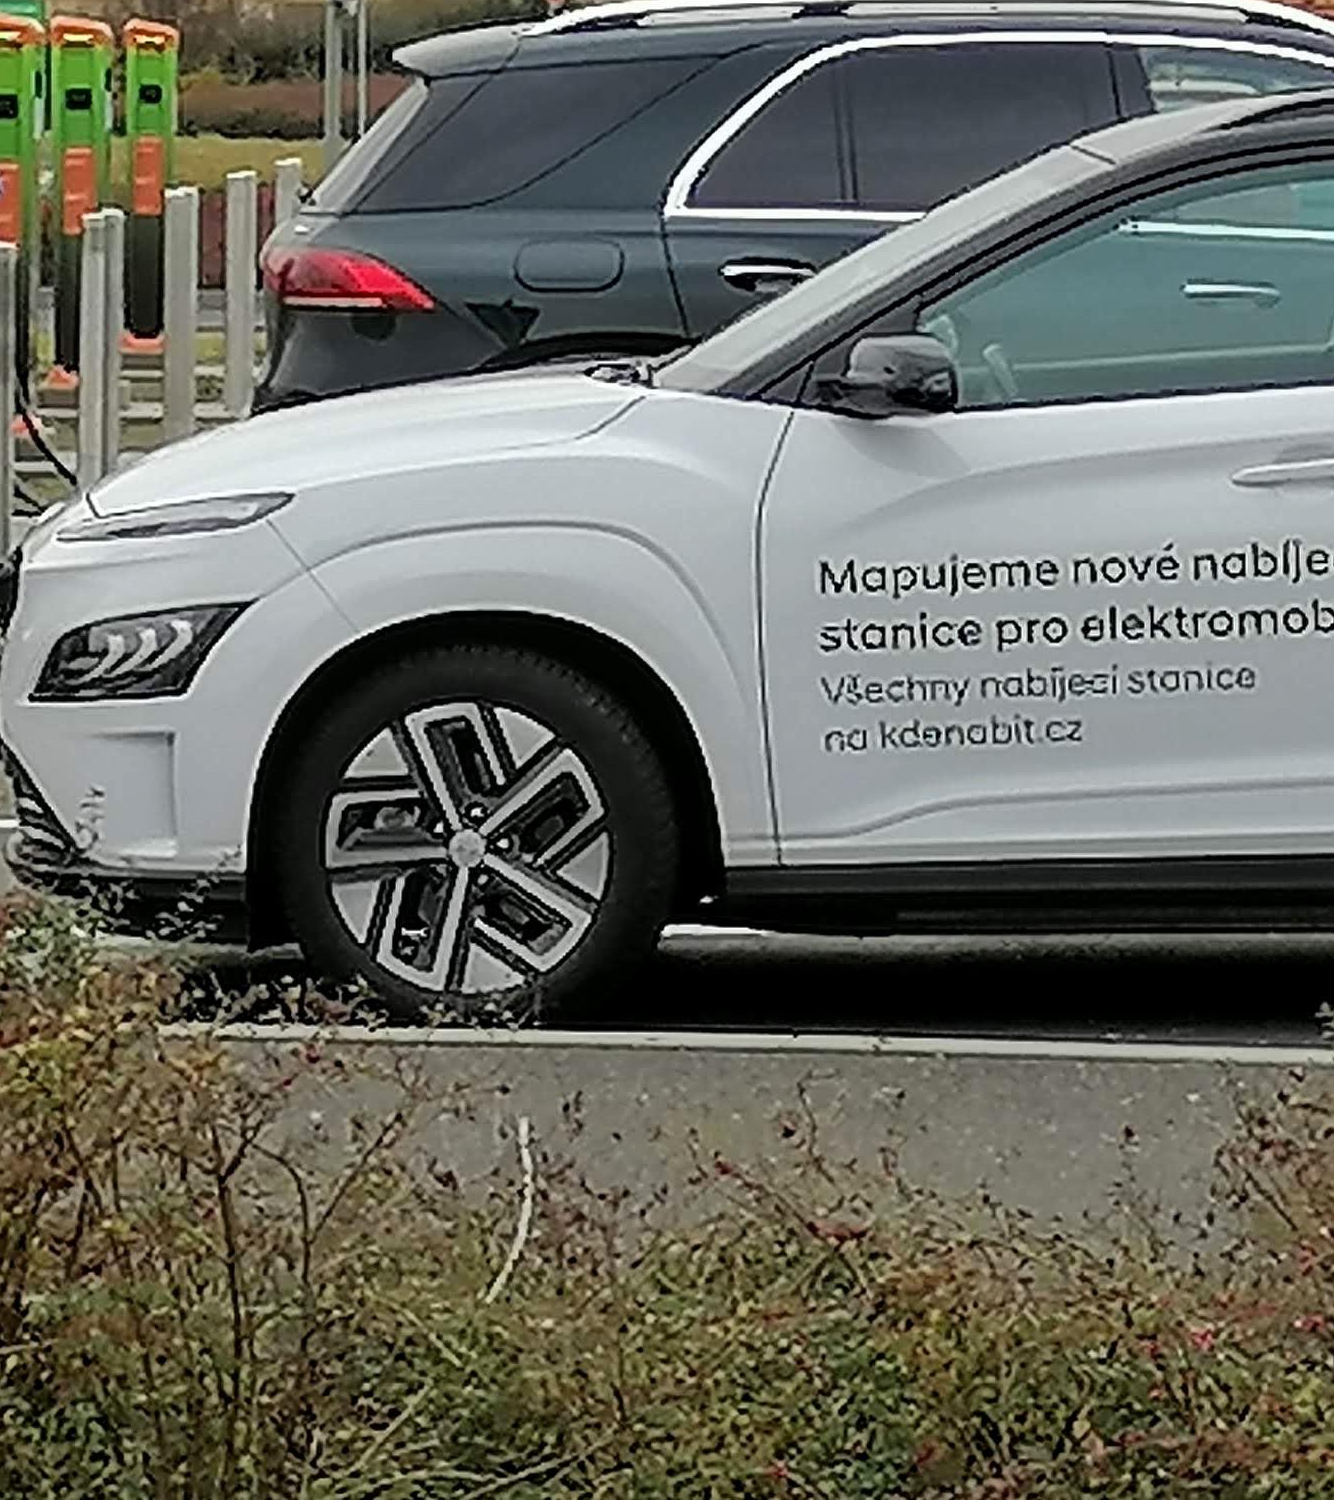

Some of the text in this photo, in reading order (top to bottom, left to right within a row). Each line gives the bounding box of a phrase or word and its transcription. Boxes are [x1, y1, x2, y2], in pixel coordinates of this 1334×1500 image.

[818, 553, 1060, 600] Mapujeme
[1072, 541, 1180, 584] nové
[818, 611, 983, 653] stanice
[995, 616, 1069, 653] pro
[819, 673, 971, 706] Všechny
[1125, 661, 1257, 695] stanice
[823, 713, 1084, 752] na kdenabit.cz
